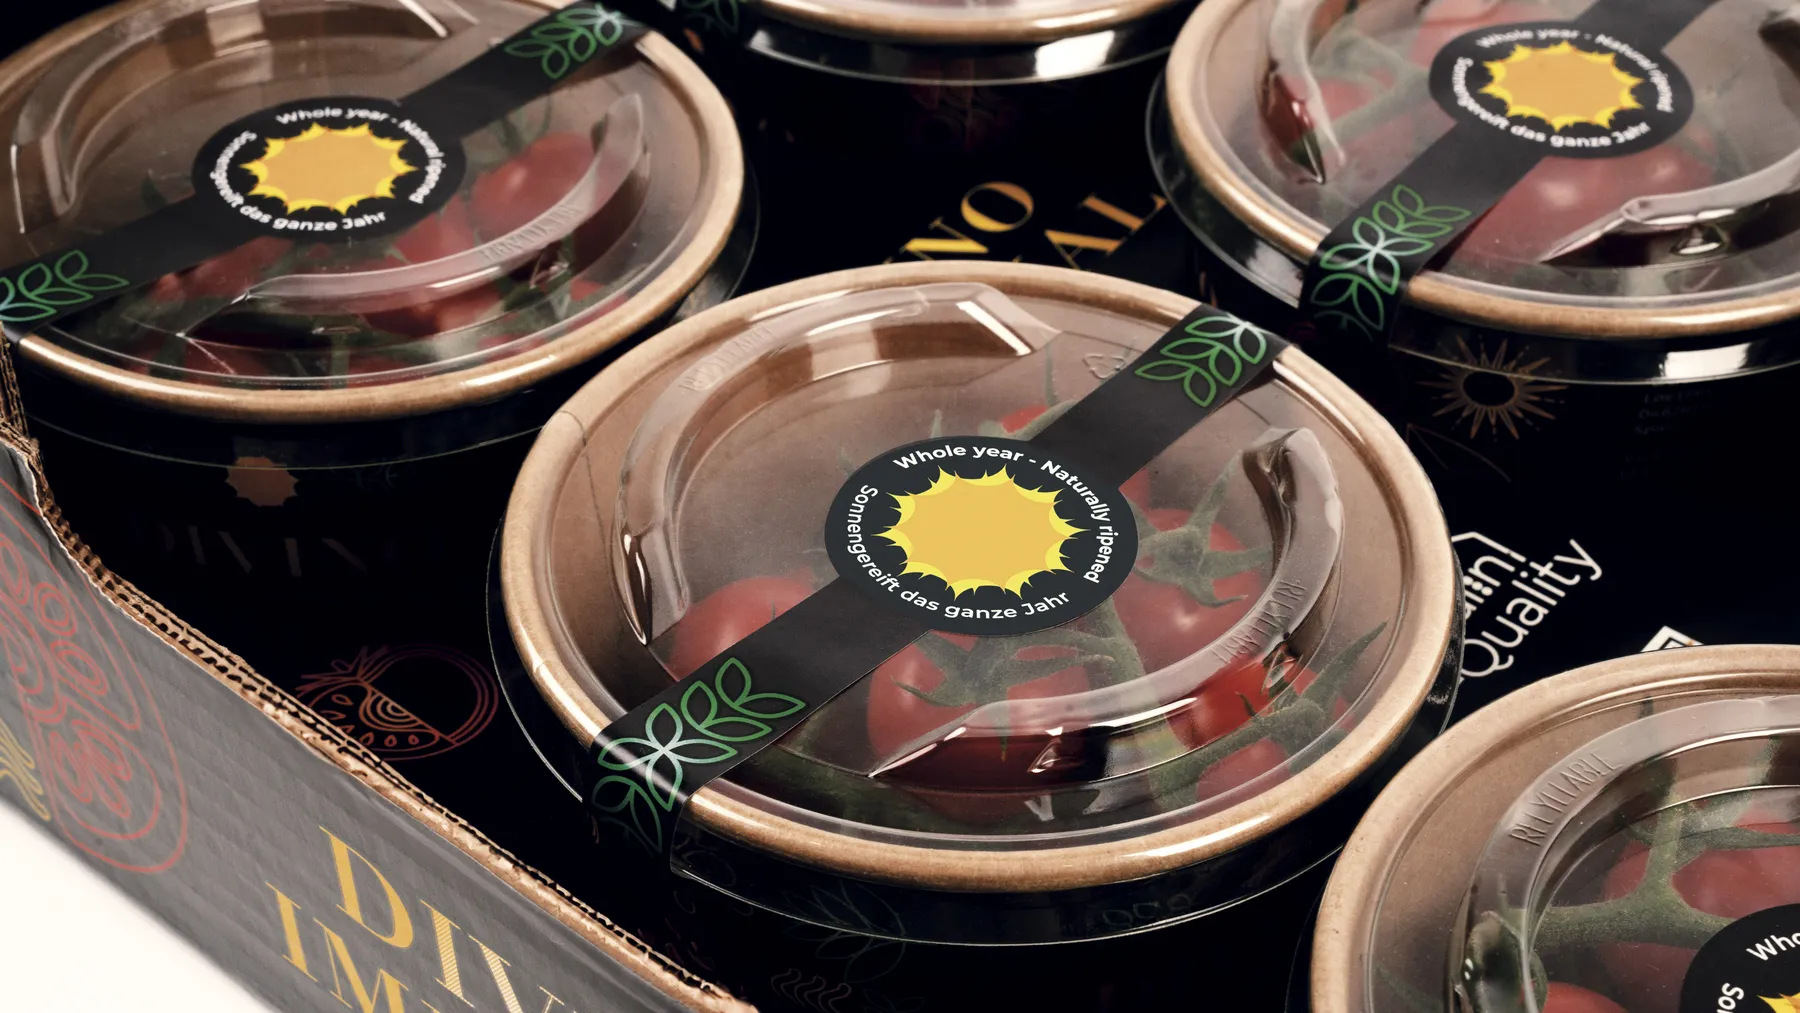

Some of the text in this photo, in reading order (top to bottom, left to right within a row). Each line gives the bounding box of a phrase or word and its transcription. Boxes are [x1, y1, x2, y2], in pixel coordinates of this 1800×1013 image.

[1476, 28, 1533, 48] Whole
[1536, 28, 1580, 39] year
[275, 106, 343, 124] Whole
[345, 107, 389, 122] year
[409, 158, 446, 204] ripened
[1510, 124, 1546, 142] das
[1550, 135, 1612, 148] ganze
[1611, 121, 1651, 143] Jahr
[239, 204, 272, 223] das
[272, 216, 337, 231] ganze
[342, 211, 386, 230] Jahr
[883, 181, 1034, 263] NO
[1013, 192, 1167, 271] AL
[847, 484, 1071, 620] Sonnengereift das ganze Jahr
[893, 444, 967, 470] Whole
[972, 445, 1024, 462] year
[1040, 460, 1112, 522] Naturally
[1083, 525, 1119, 584] ripened
[1461, 538, 1603, 677] Quality
[265, 881, 441, 1013] IM
